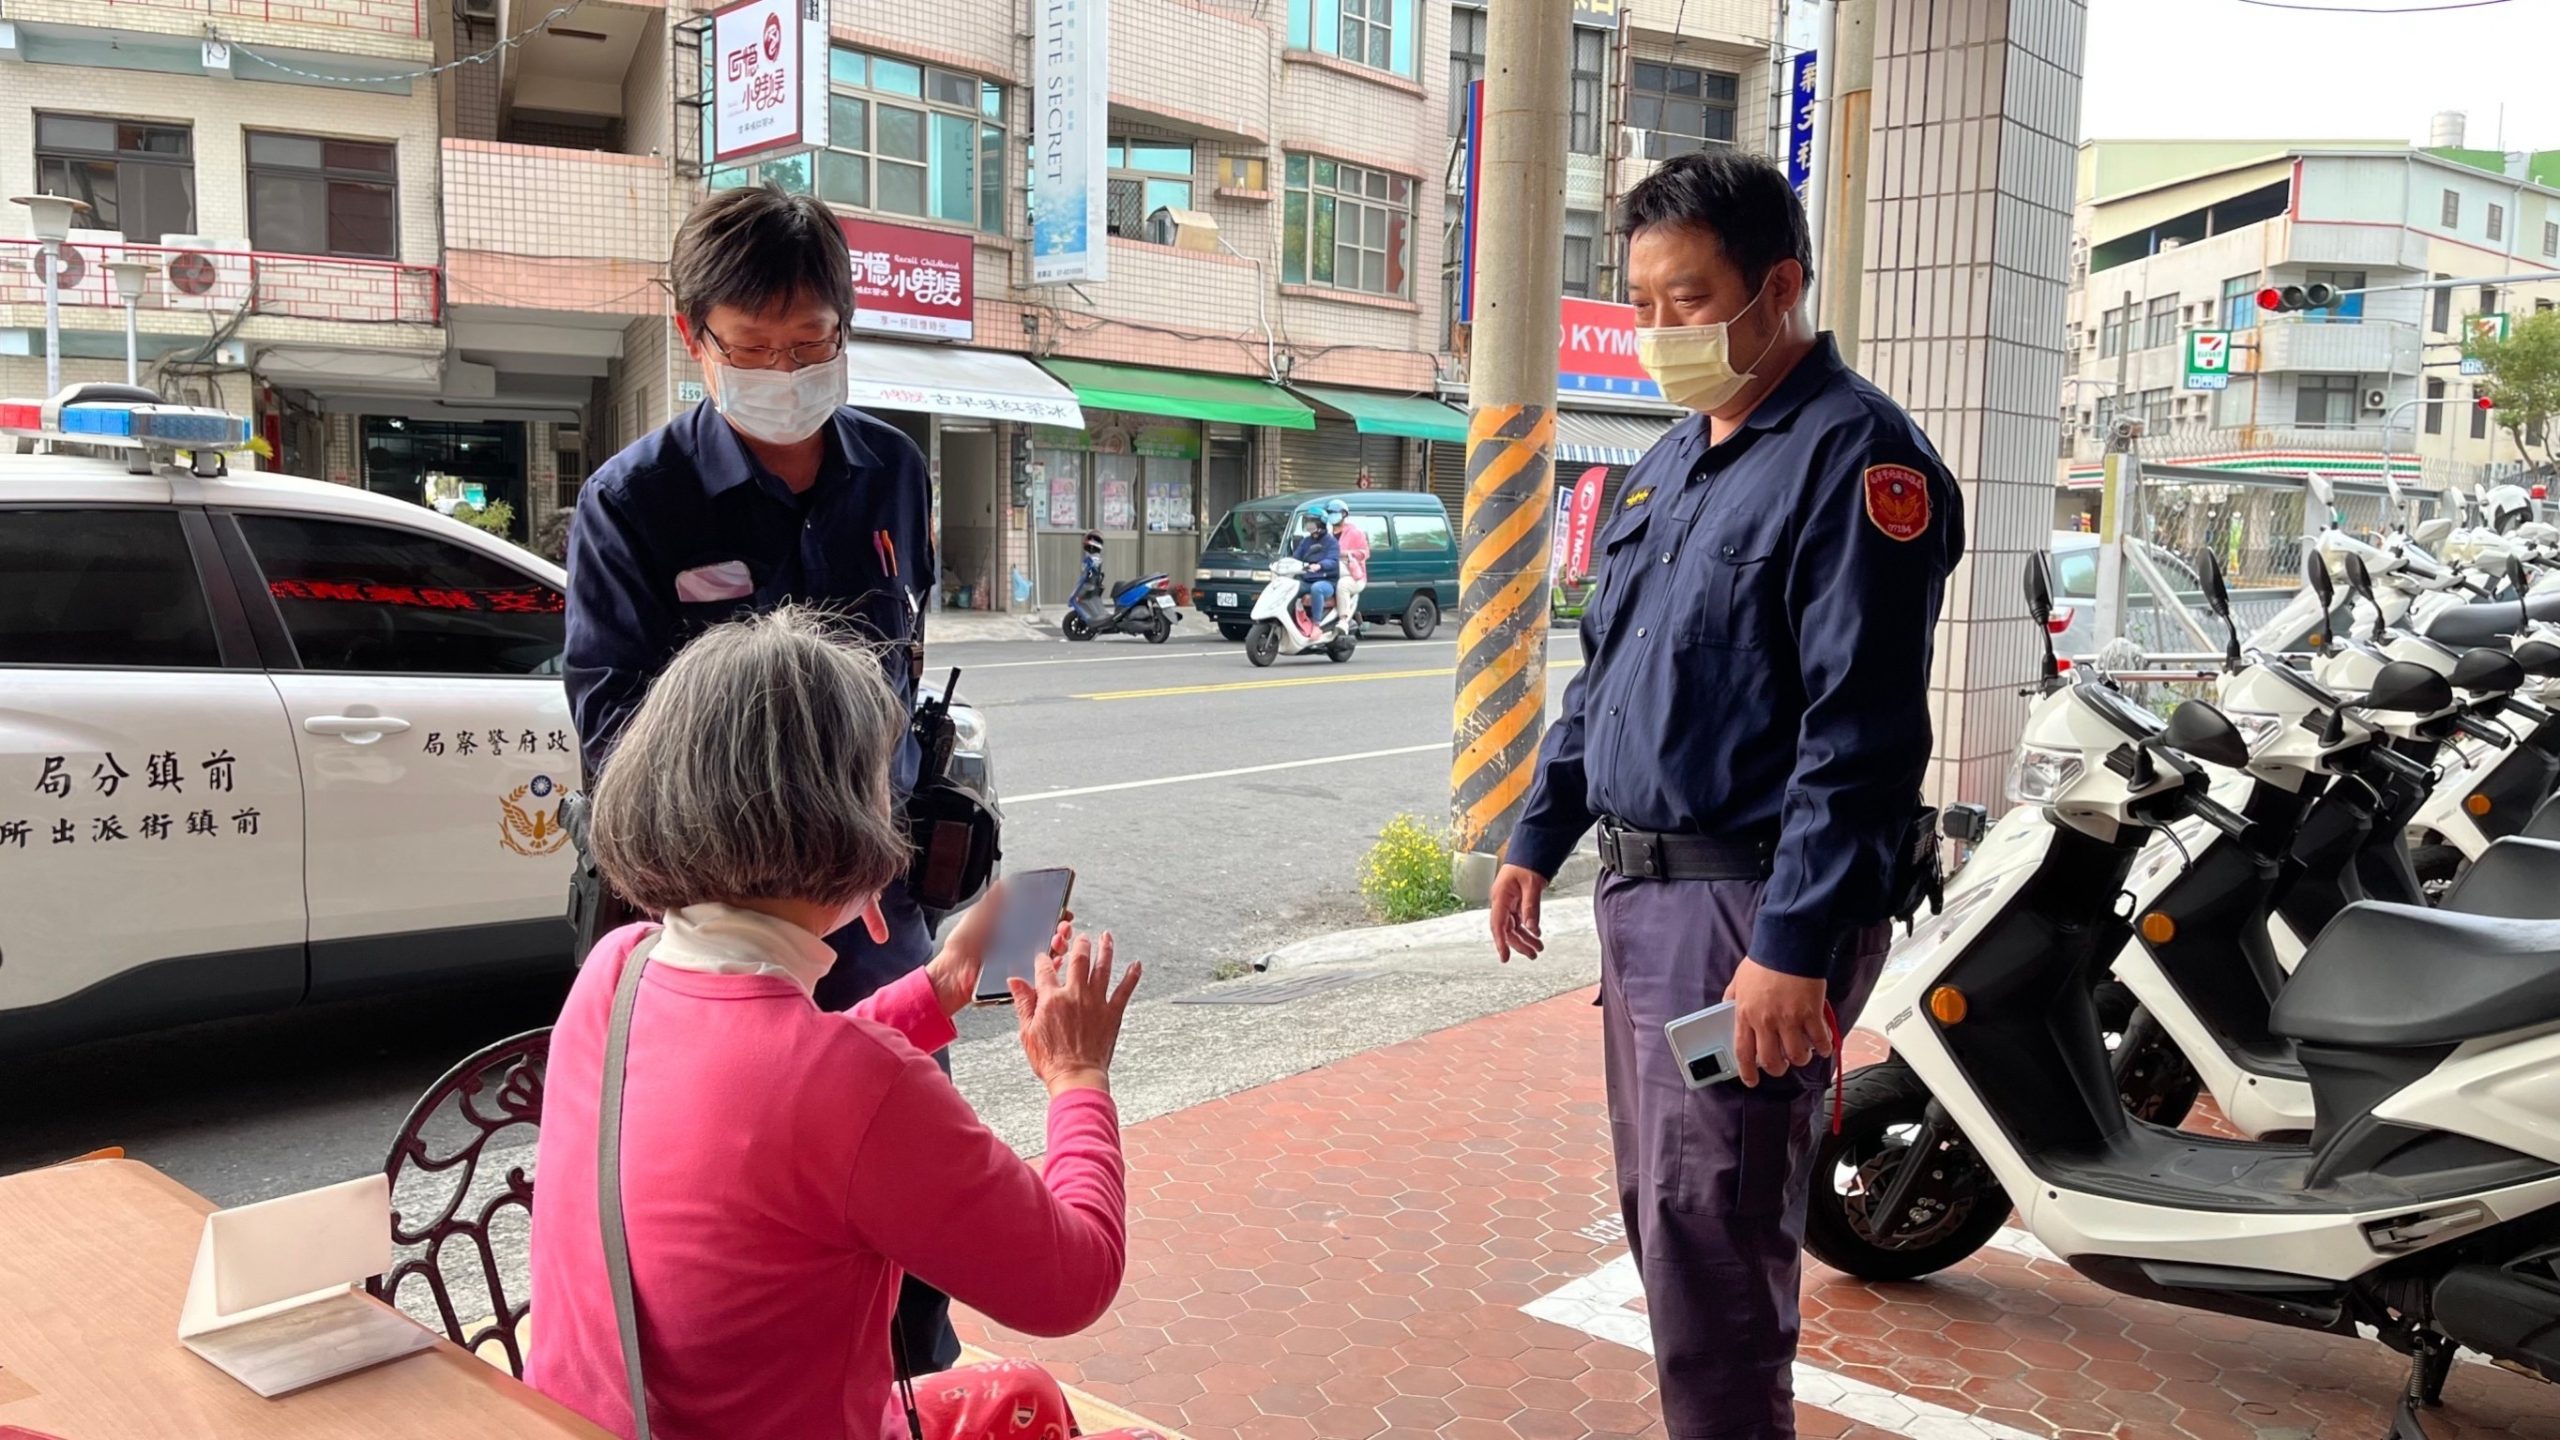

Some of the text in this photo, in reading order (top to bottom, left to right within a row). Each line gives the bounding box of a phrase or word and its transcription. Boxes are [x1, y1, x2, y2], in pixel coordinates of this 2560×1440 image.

[1047, 0, 1062, 184] LITE SECRET
[1571, 323, 1640, 357] KYM
[682, 389, 701, 400] 259
[1569, 512, 1588, 582] KYMCO
[1885, 1006, 1913, 1035] ABS
